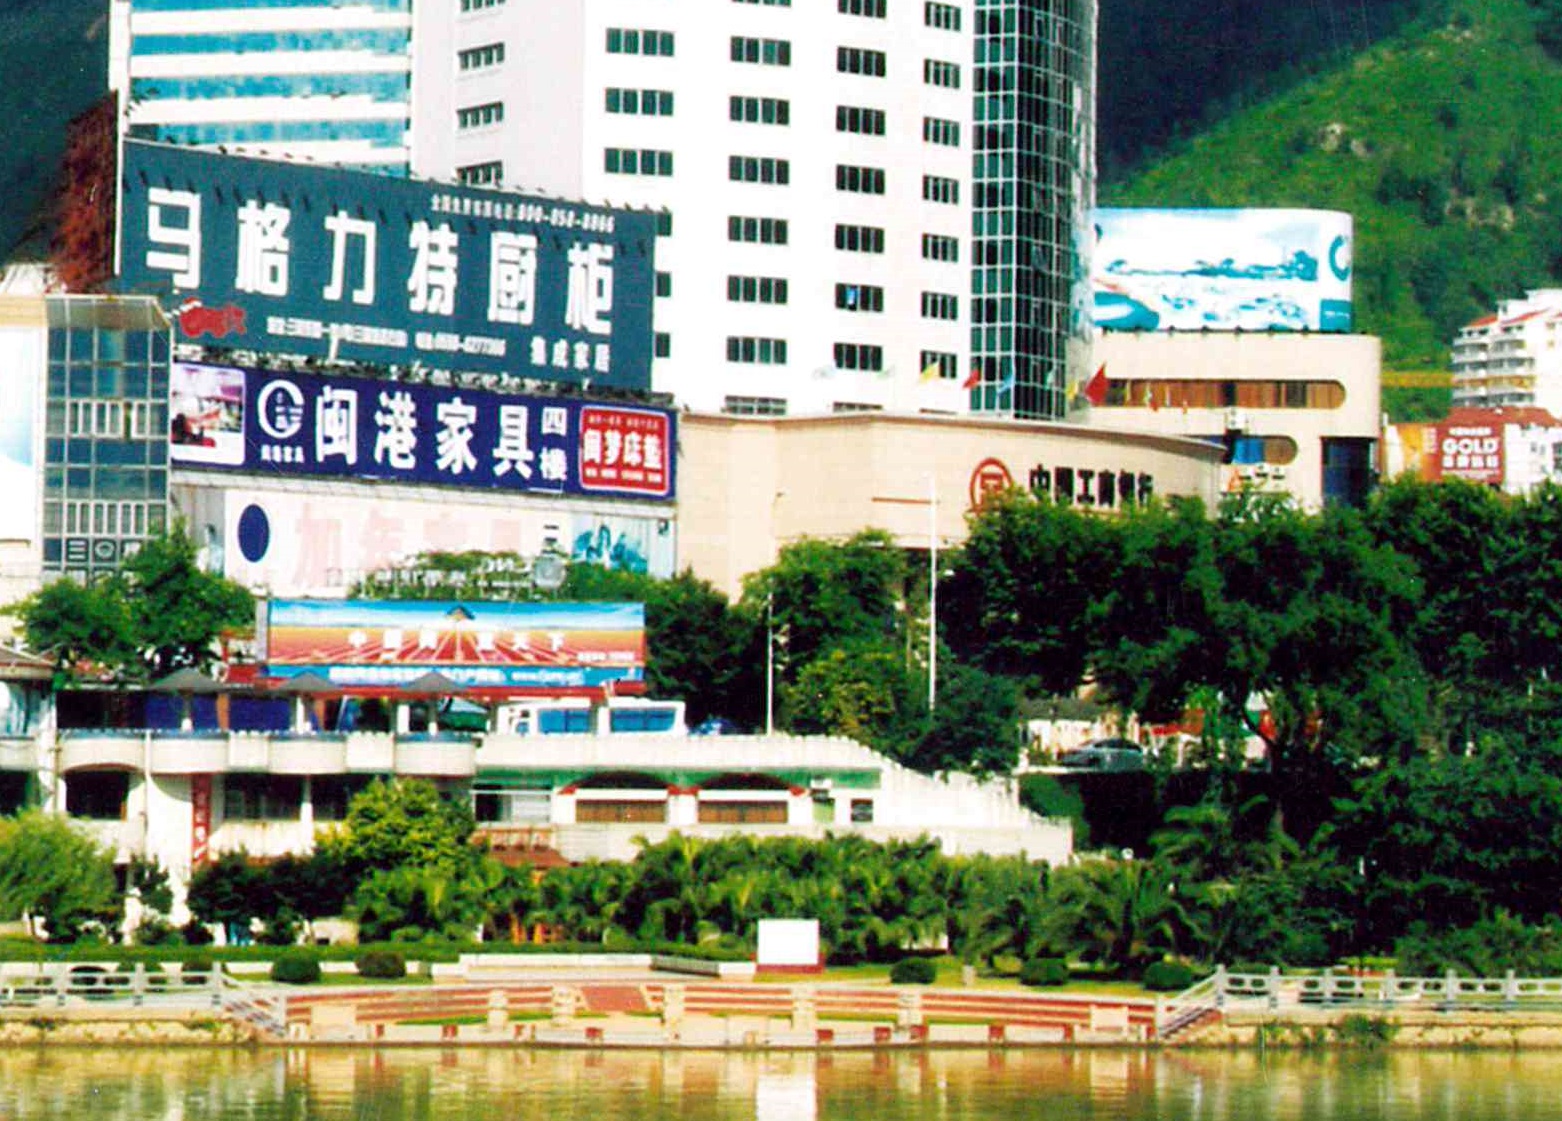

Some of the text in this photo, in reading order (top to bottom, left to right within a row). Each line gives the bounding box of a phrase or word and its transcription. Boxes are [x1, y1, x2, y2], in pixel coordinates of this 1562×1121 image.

[316, 385, 534, 479] 闽港家具
[1442, 438, 1500, 455] GOLD
